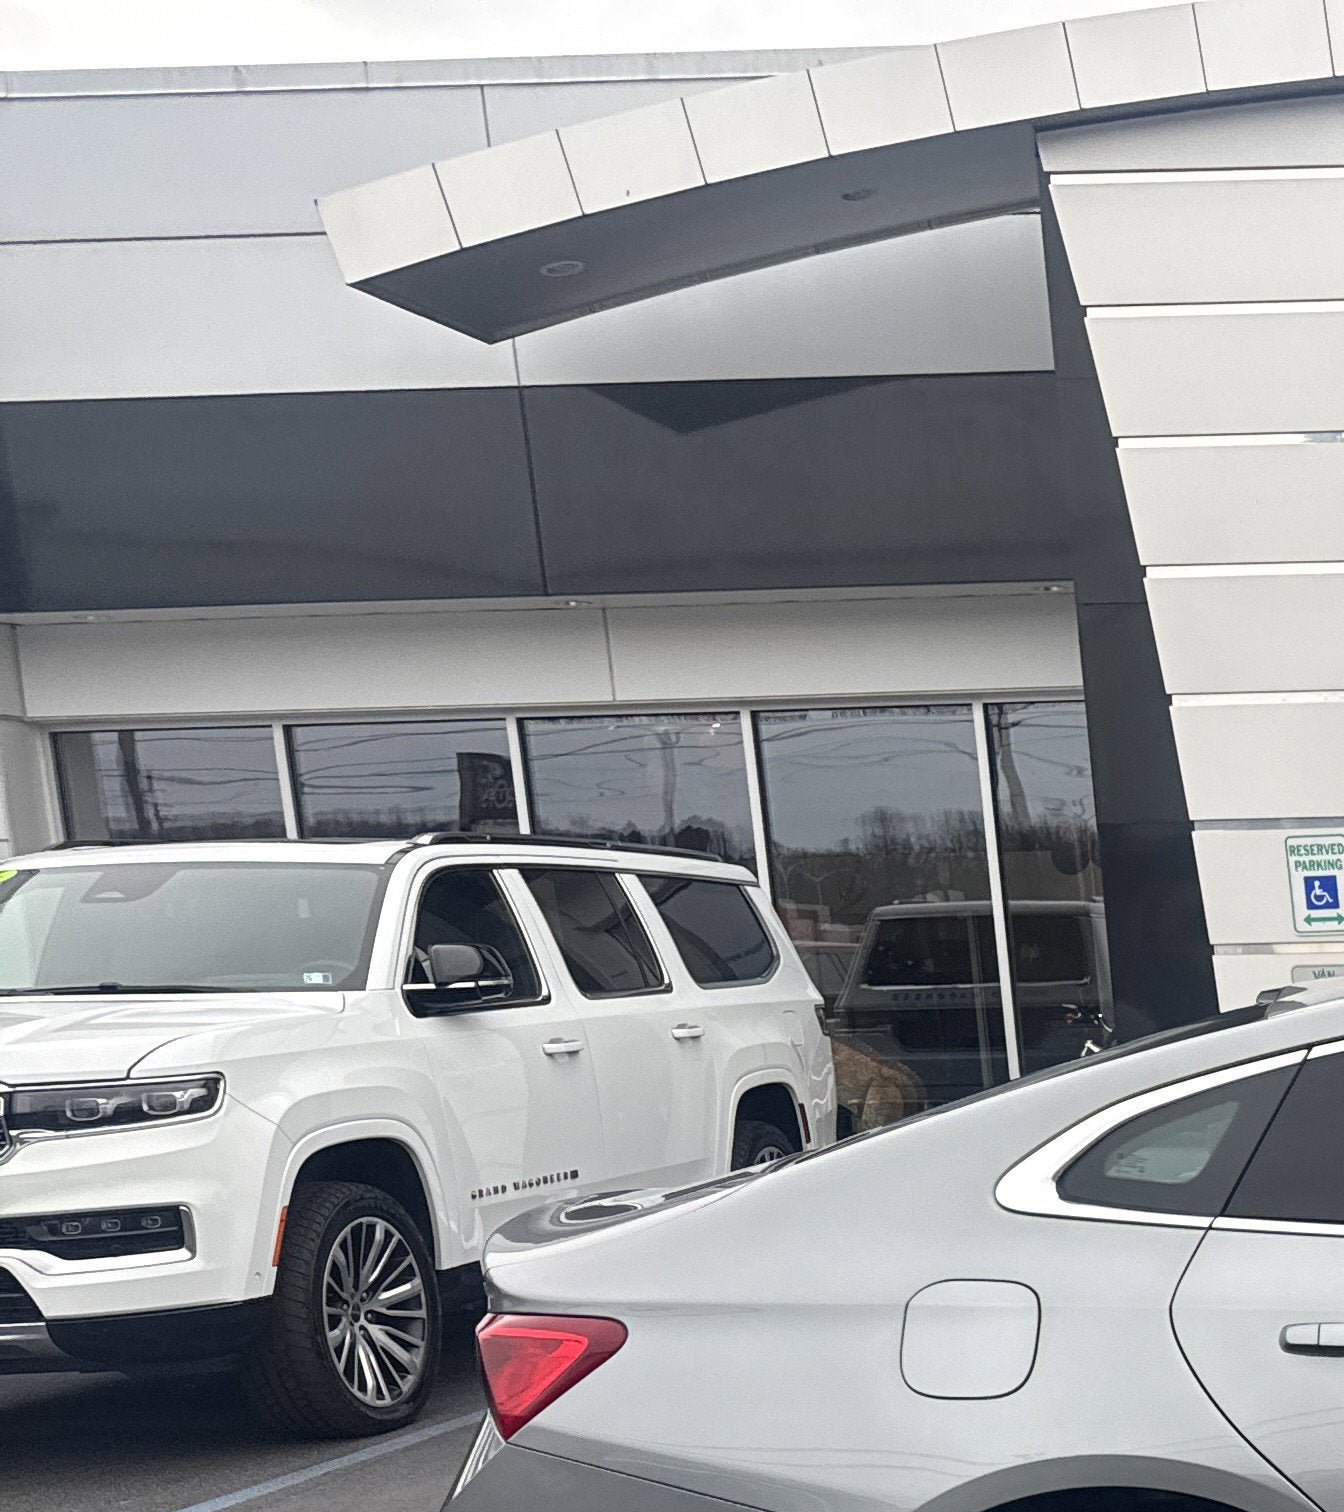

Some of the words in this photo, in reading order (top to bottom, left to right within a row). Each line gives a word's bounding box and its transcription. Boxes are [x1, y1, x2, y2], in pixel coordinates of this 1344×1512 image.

[1288, 842, 1344, 857] RESERVED
[1294, 859, 1344, 872] PARKING
[470, 1184, 507, 1200] GRAND
